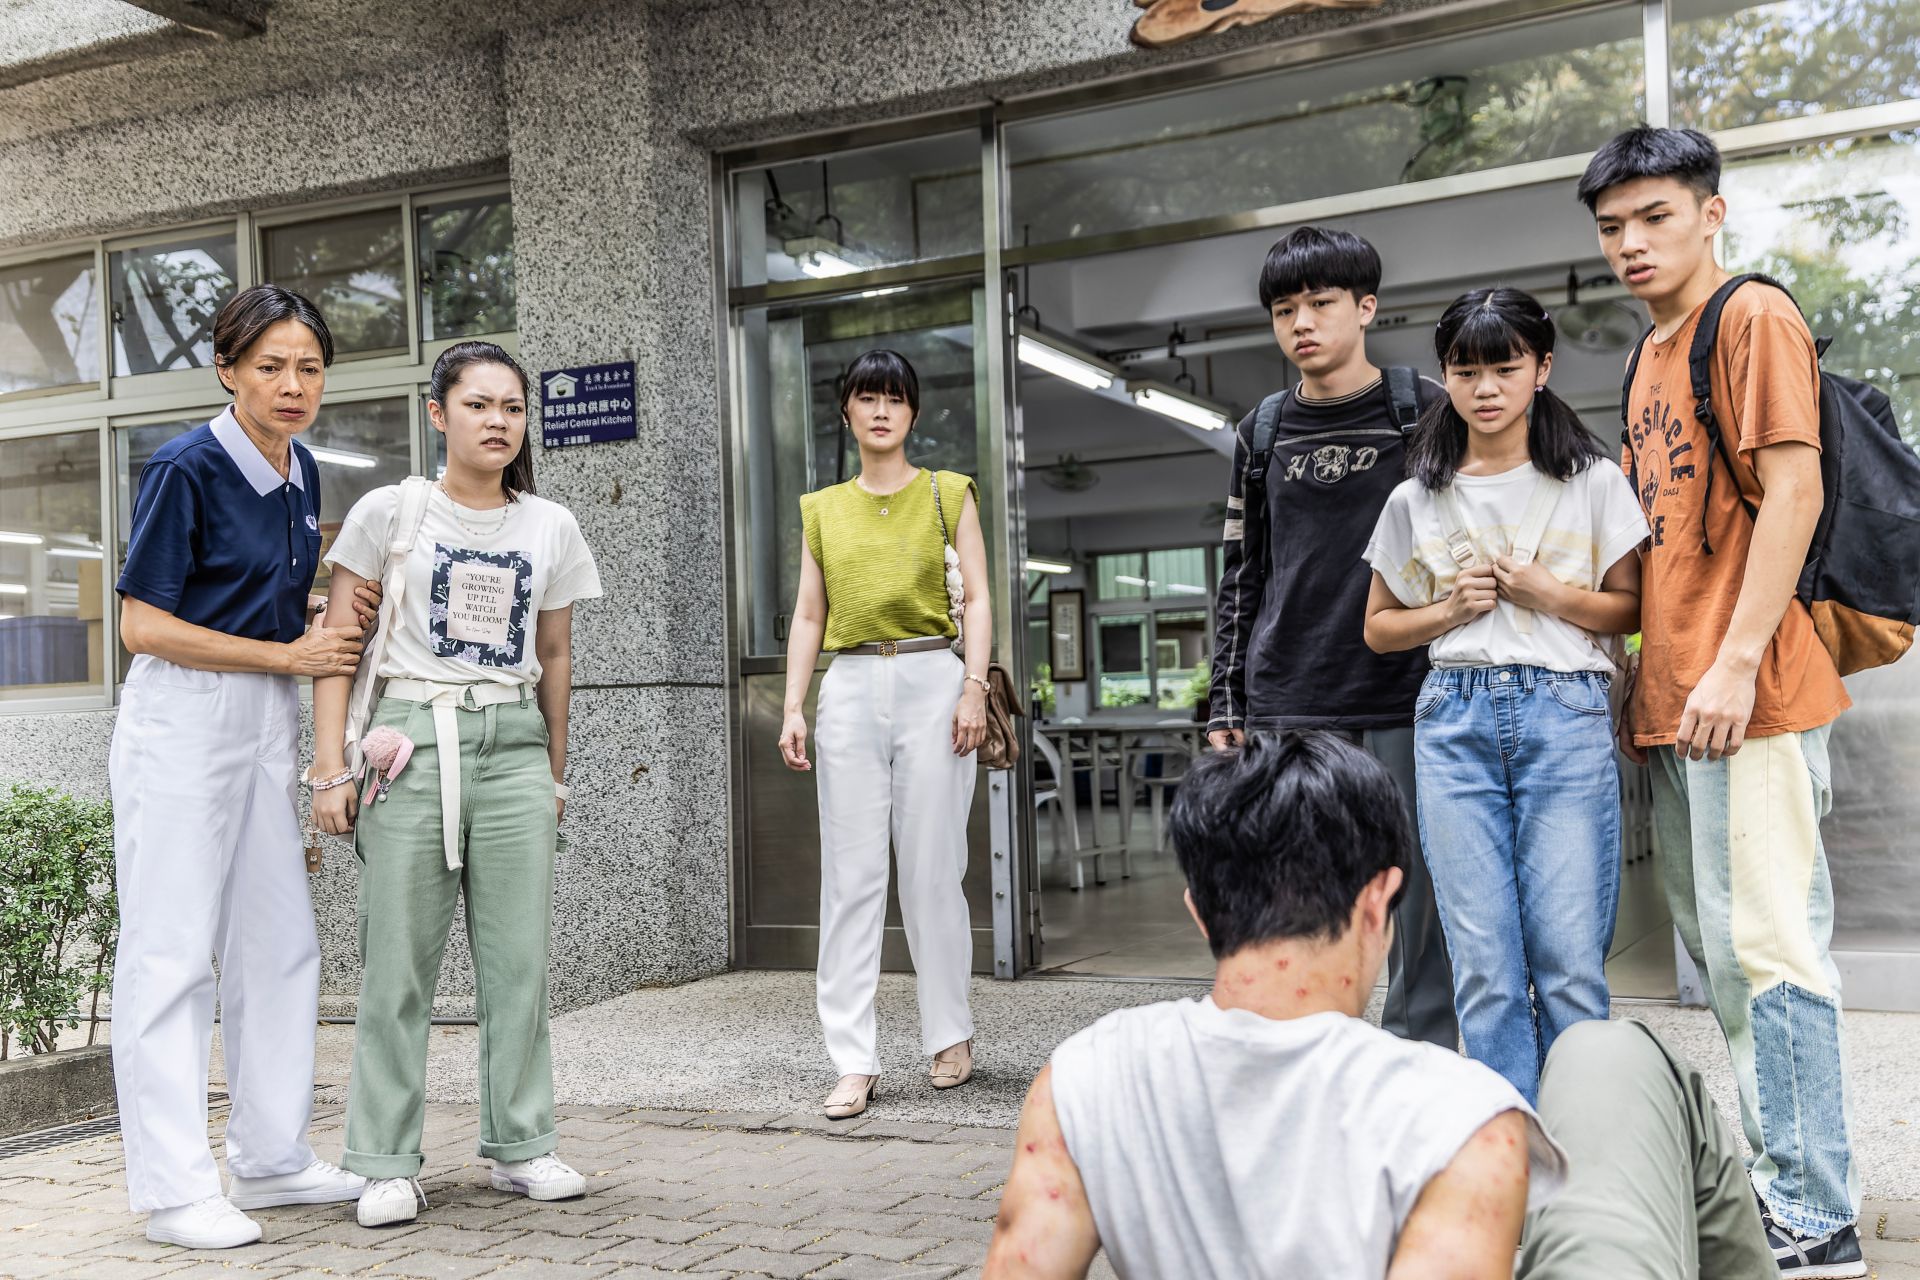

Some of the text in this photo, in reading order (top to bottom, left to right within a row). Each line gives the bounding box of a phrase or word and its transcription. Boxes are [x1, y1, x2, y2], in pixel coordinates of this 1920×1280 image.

[544, 414, 633, 431] Relief Central Kitchen
[461, 583, 505, 595] GROWING
[467, 593, 479, 601] UP
[465, 603, 497, 614] WATCH
[452, 612, 507, 625] YOU BLOOM”
